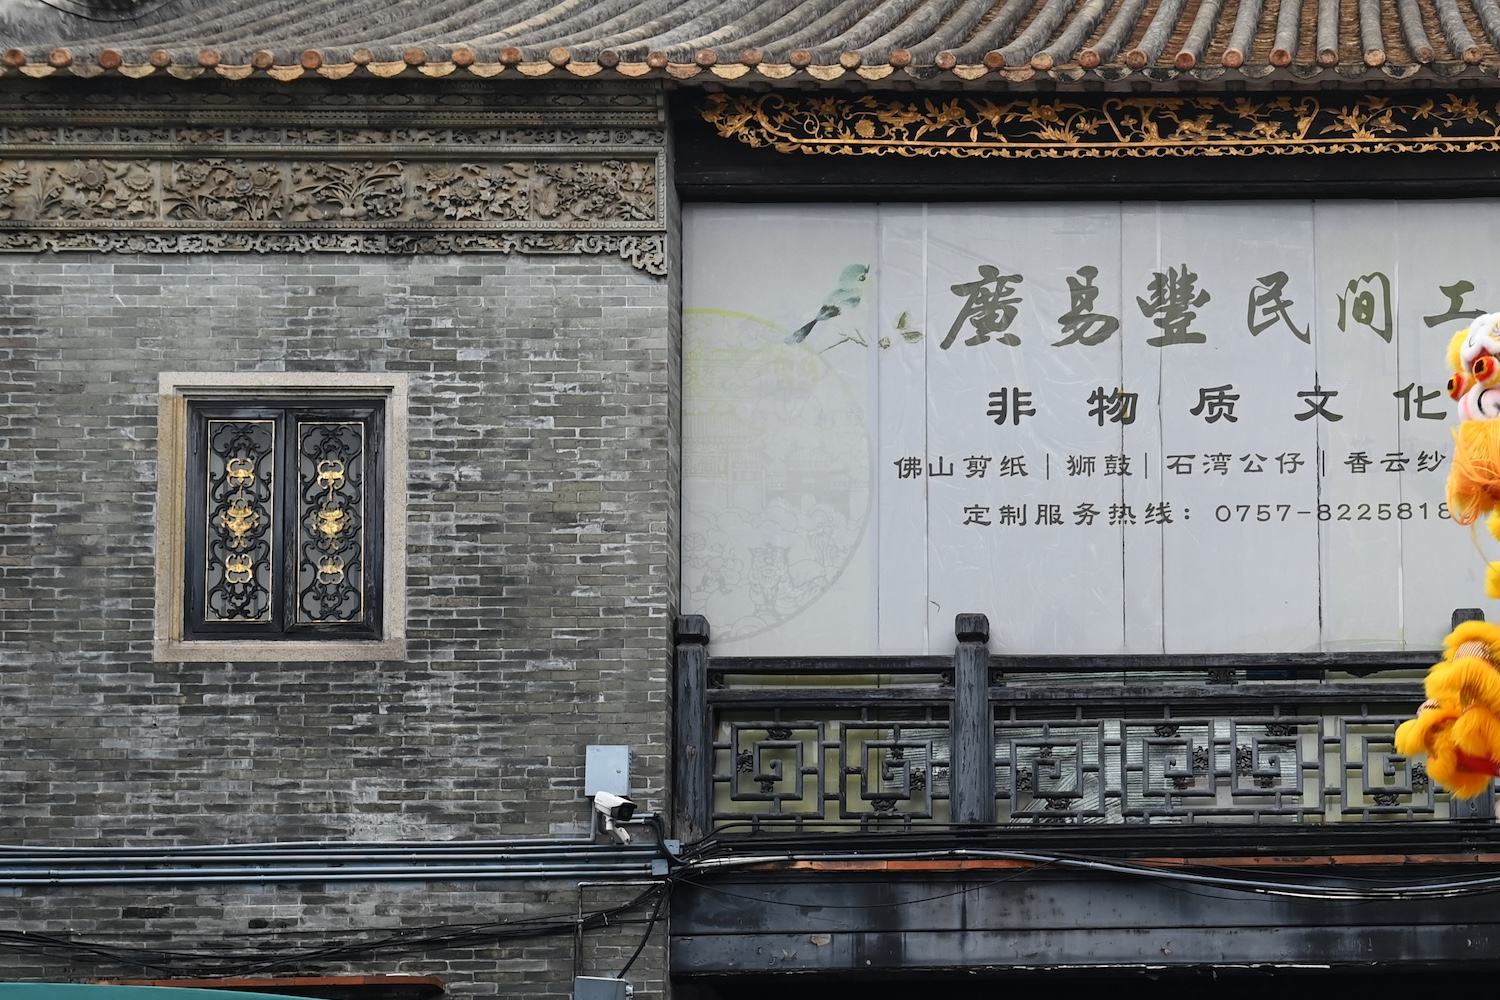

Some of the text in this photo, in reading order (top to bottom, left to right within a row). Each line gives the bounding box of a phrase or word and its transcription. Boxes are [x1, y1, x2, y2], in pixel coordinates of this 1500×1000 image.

[985, 382, 1447, 426] 非物质文化
[893, 450, 1446, 480] 佛山剪纸 狮鼓 石湾公仔 香云纱
